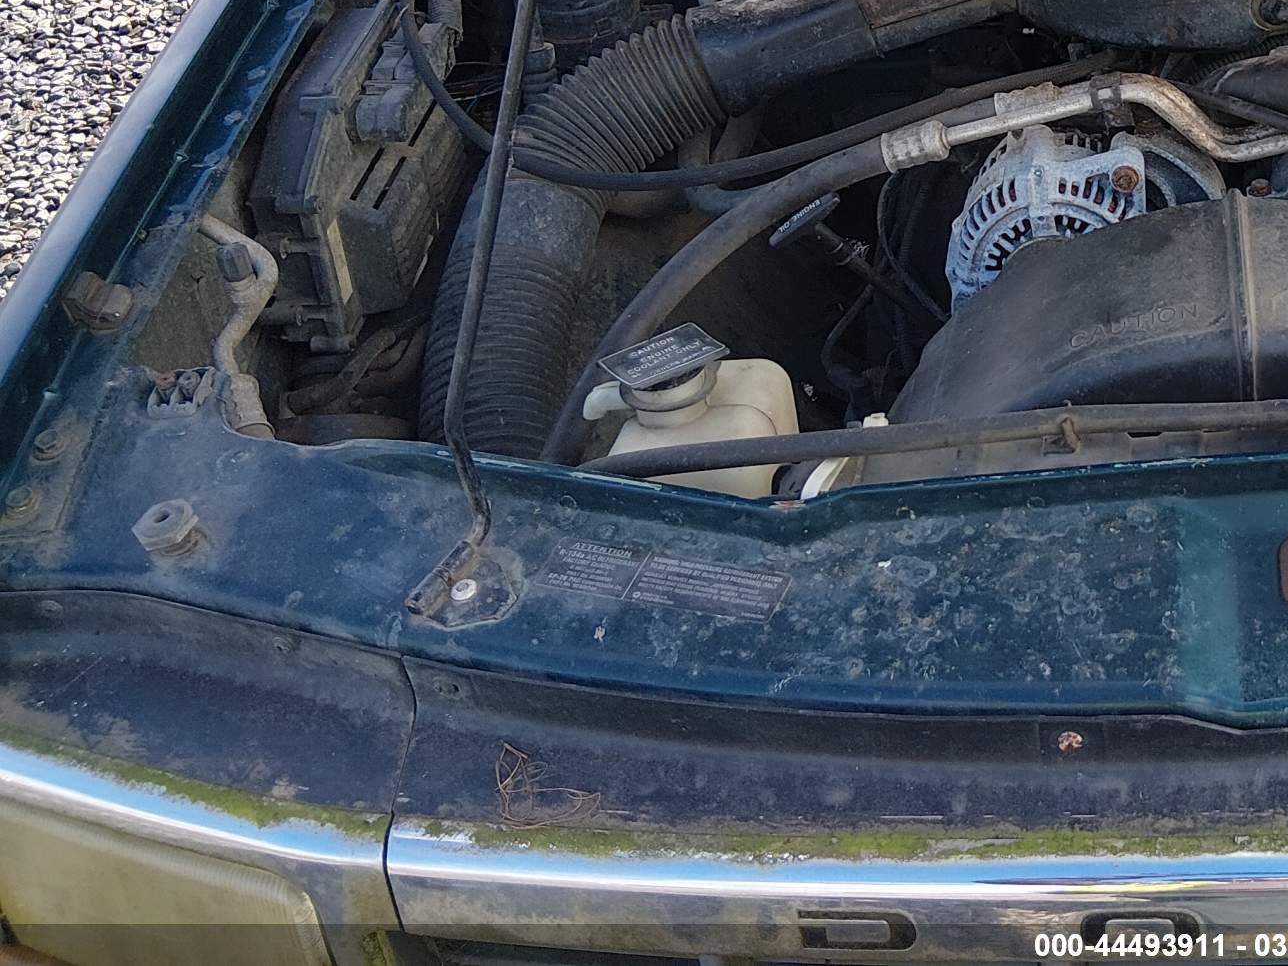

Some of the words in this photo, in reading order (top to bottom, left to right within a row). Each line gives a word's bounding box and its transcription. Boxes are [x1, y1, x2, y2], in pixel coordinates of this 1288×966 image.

[1071, 304, 1197, 348] CAUTION
[630, 336, 675, 358] CAUTION
[639, 344, 679, 363] ENGINE
[627, 353, 672, 374] COOLANT
[572, 542, 633, 559] ATTENTION
